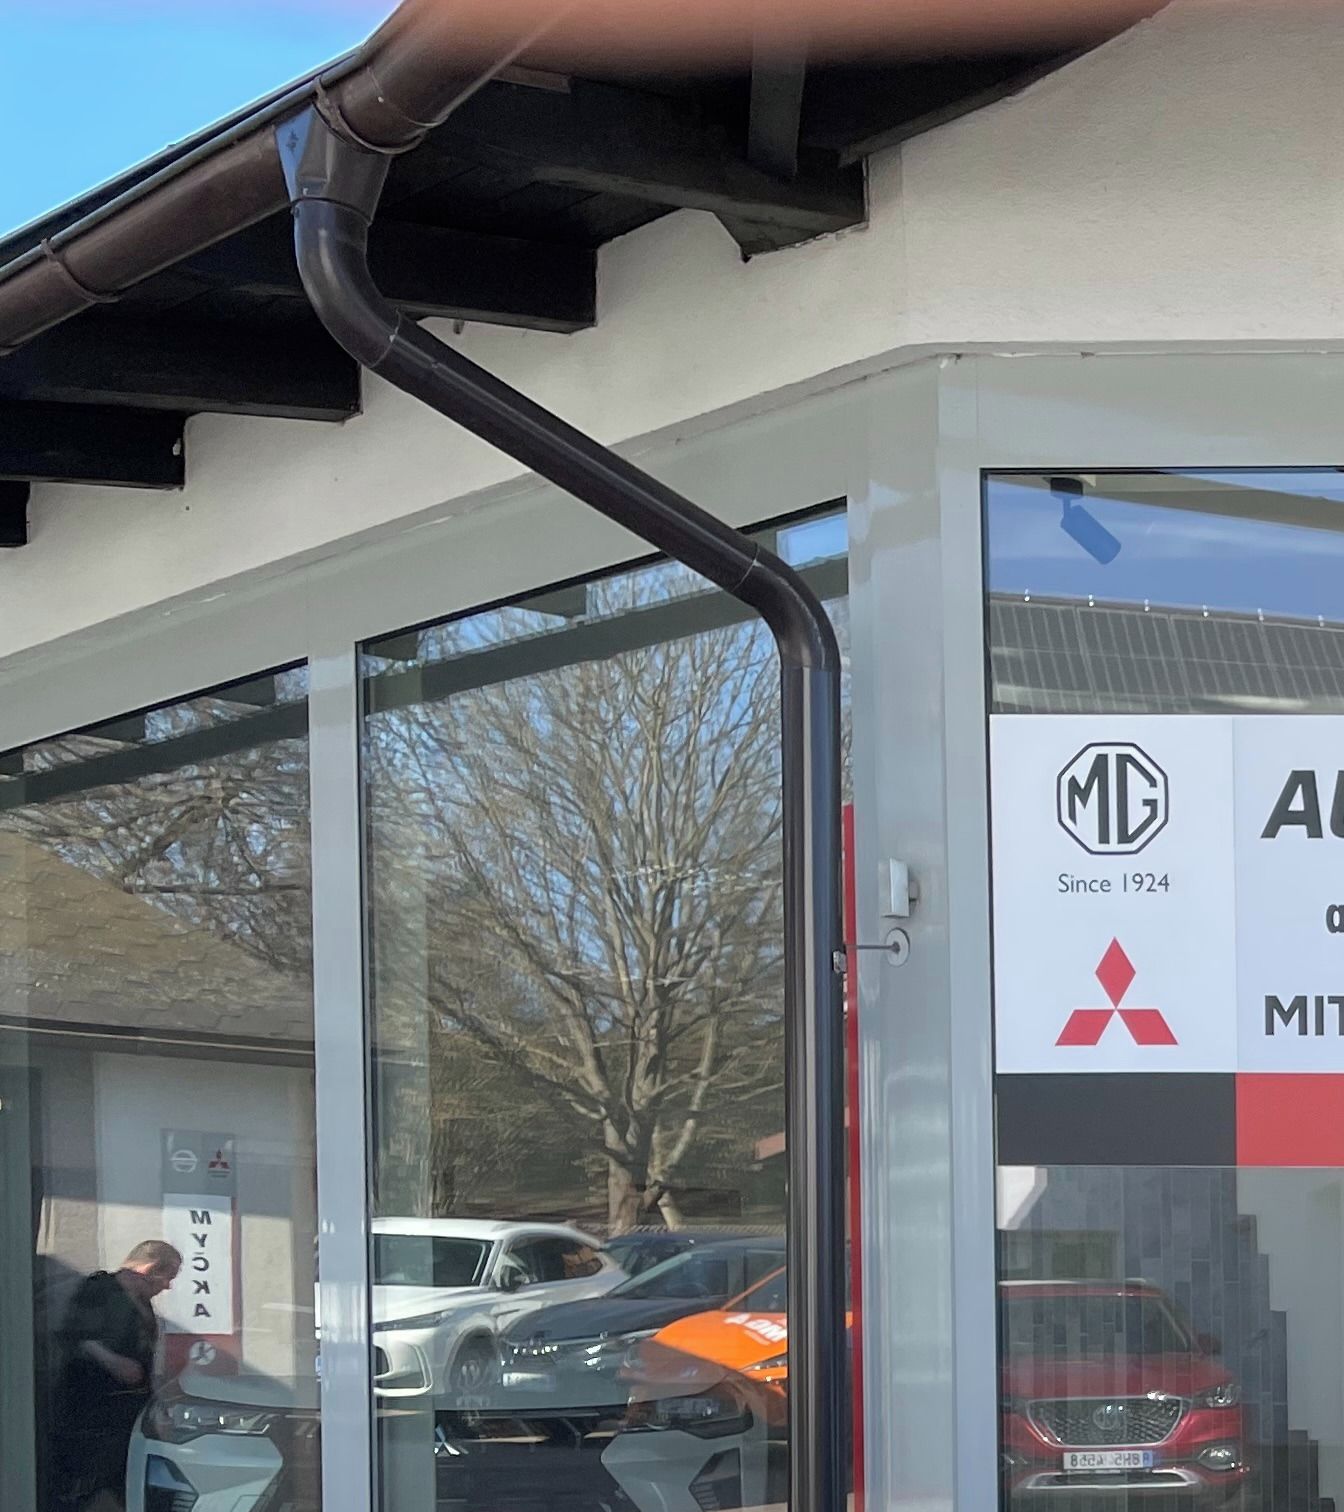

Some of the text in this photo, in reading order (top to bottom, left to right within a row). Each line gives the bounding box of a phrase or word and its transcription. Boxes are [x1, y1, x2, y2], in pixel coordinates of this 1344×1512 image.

[1065, 752, 1160, 846] MG
[1058, 872, 1170, 893] Since 1924
